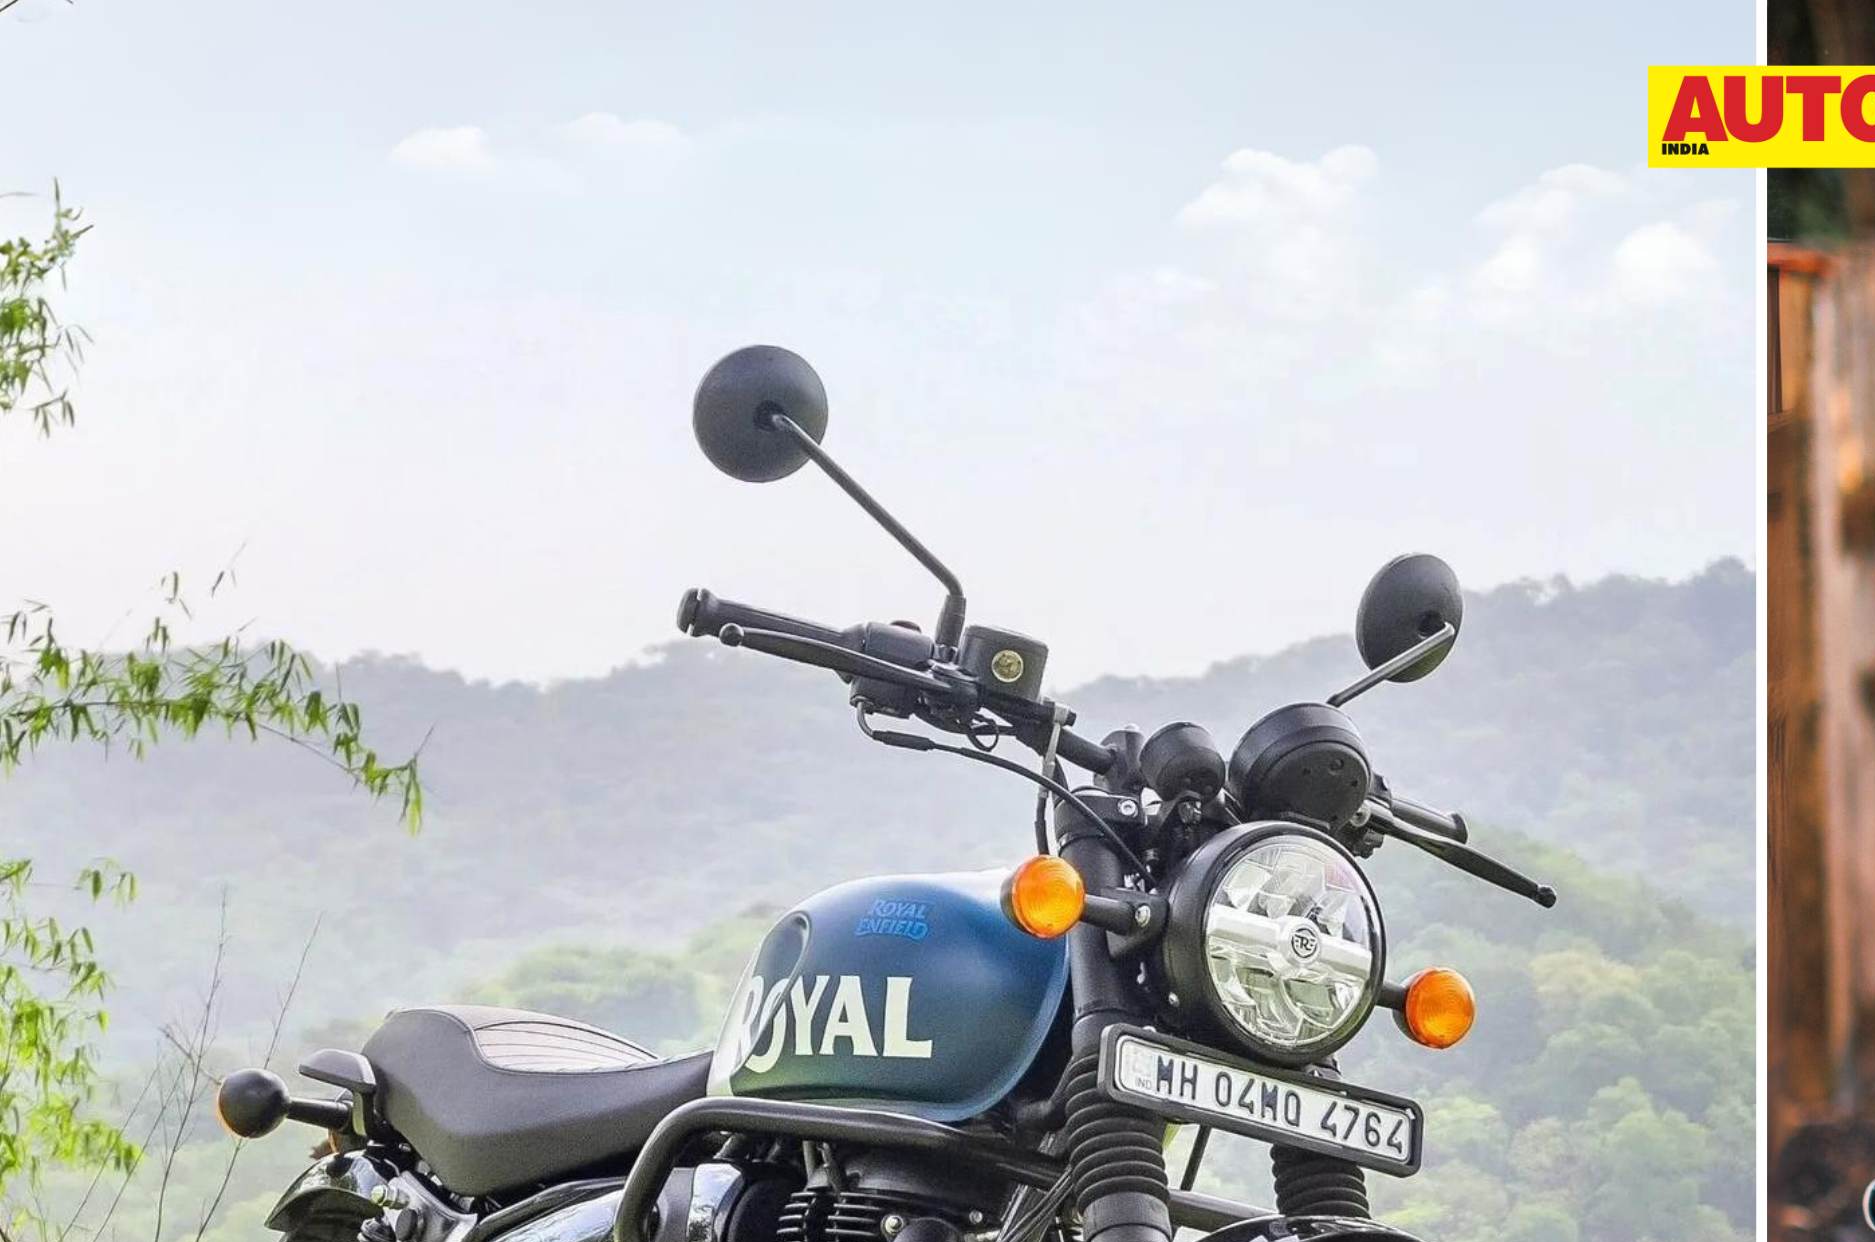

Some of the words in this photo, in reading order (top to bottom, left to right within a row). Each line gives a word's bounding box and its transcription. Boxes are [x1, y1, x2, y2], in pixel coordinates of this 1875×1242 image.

[855, 918, 928, 941] ENFIELD
[872, 899, 926, 920] ROYAL
[728, 974, 933, 1073] ROYAL
[1157, 1055, 1198, 1100] MH
[1215, 1071, 1301, 1127] 04MQ
[1320, 1101, 1404, 1154] 4764
